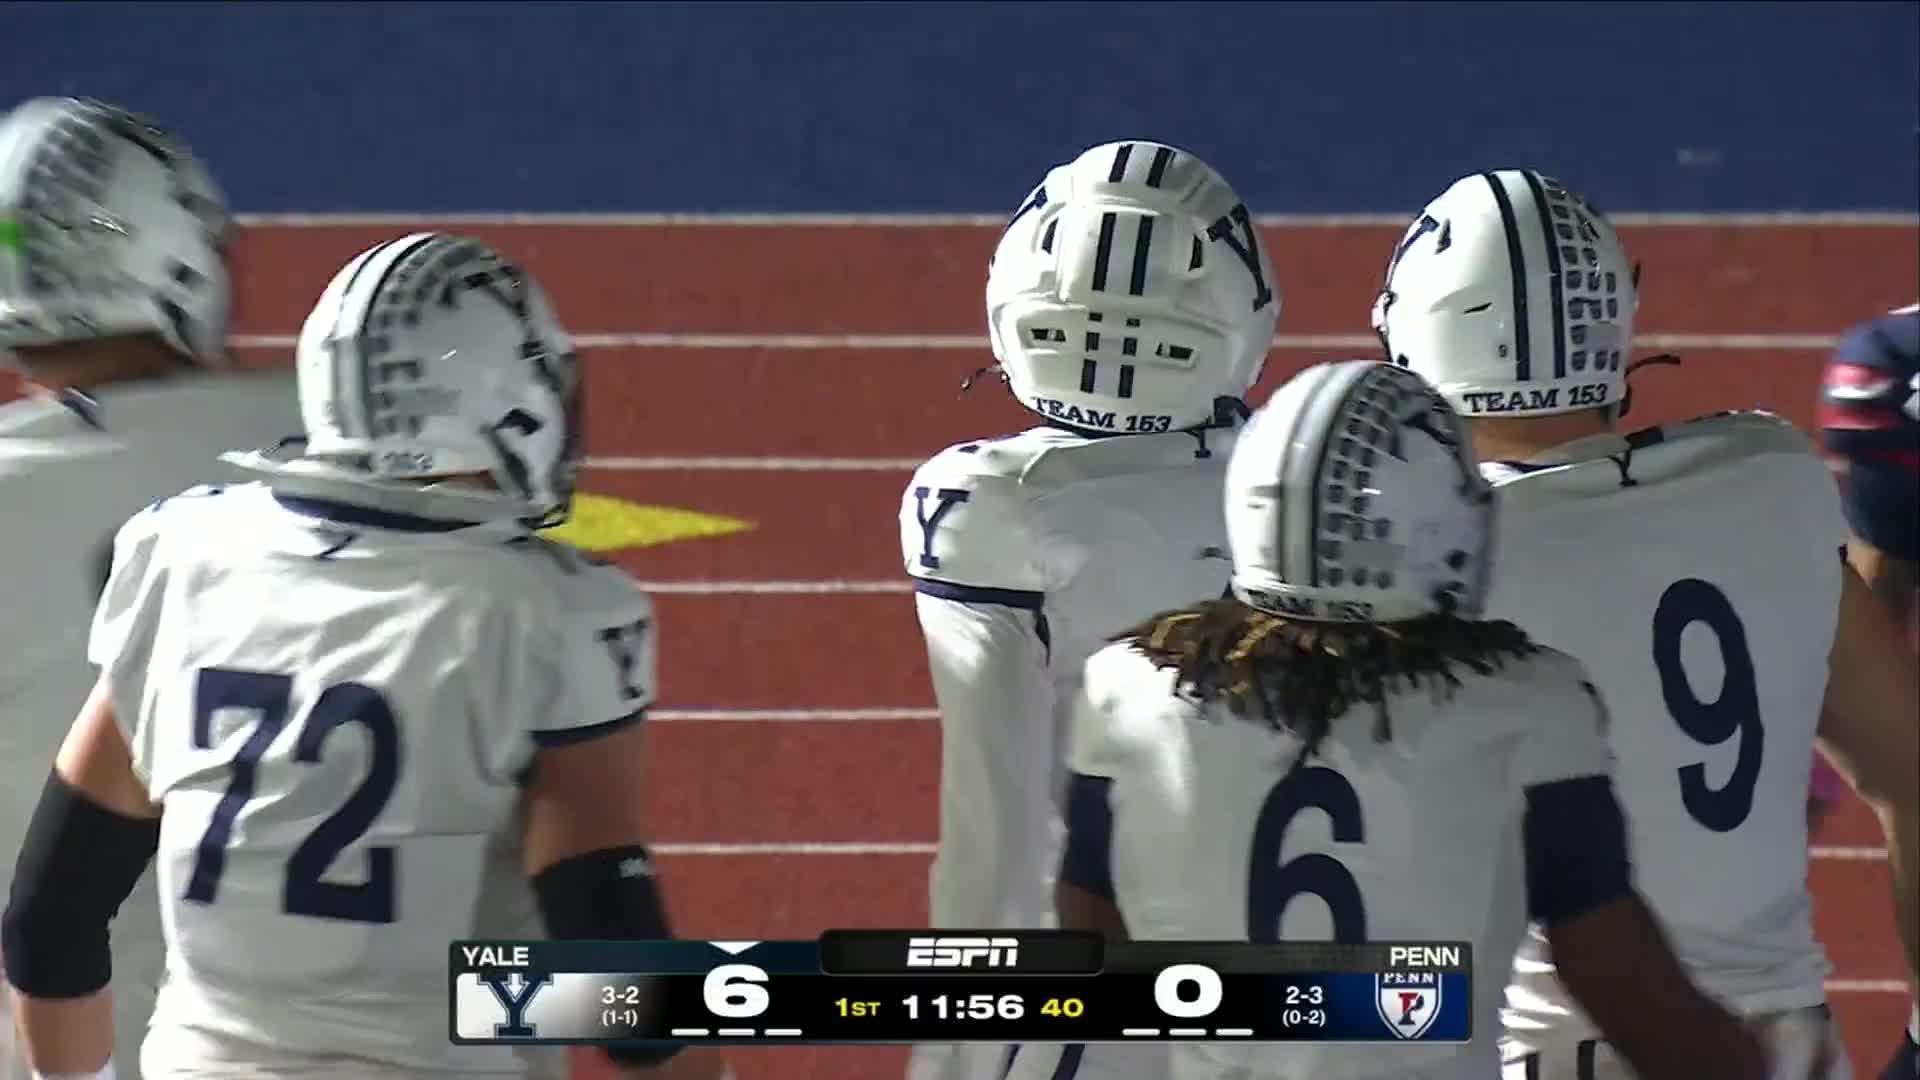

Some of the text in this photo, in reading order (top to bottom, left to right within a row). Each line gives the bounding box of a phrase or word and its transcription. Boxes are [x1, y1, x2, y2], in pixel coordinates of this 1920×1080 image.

[1206, 202, 1272, 313] Y
[1031, 396, 1172, 432] TEAM 153
[1463, 383, 1608, 413] TEAM 153
[914, 486, 972, 569] Y
[1653, 578, 1764, 832] 9
[183, 667, 401, 924] 72
[1247, 766, 1367, 943] 6
